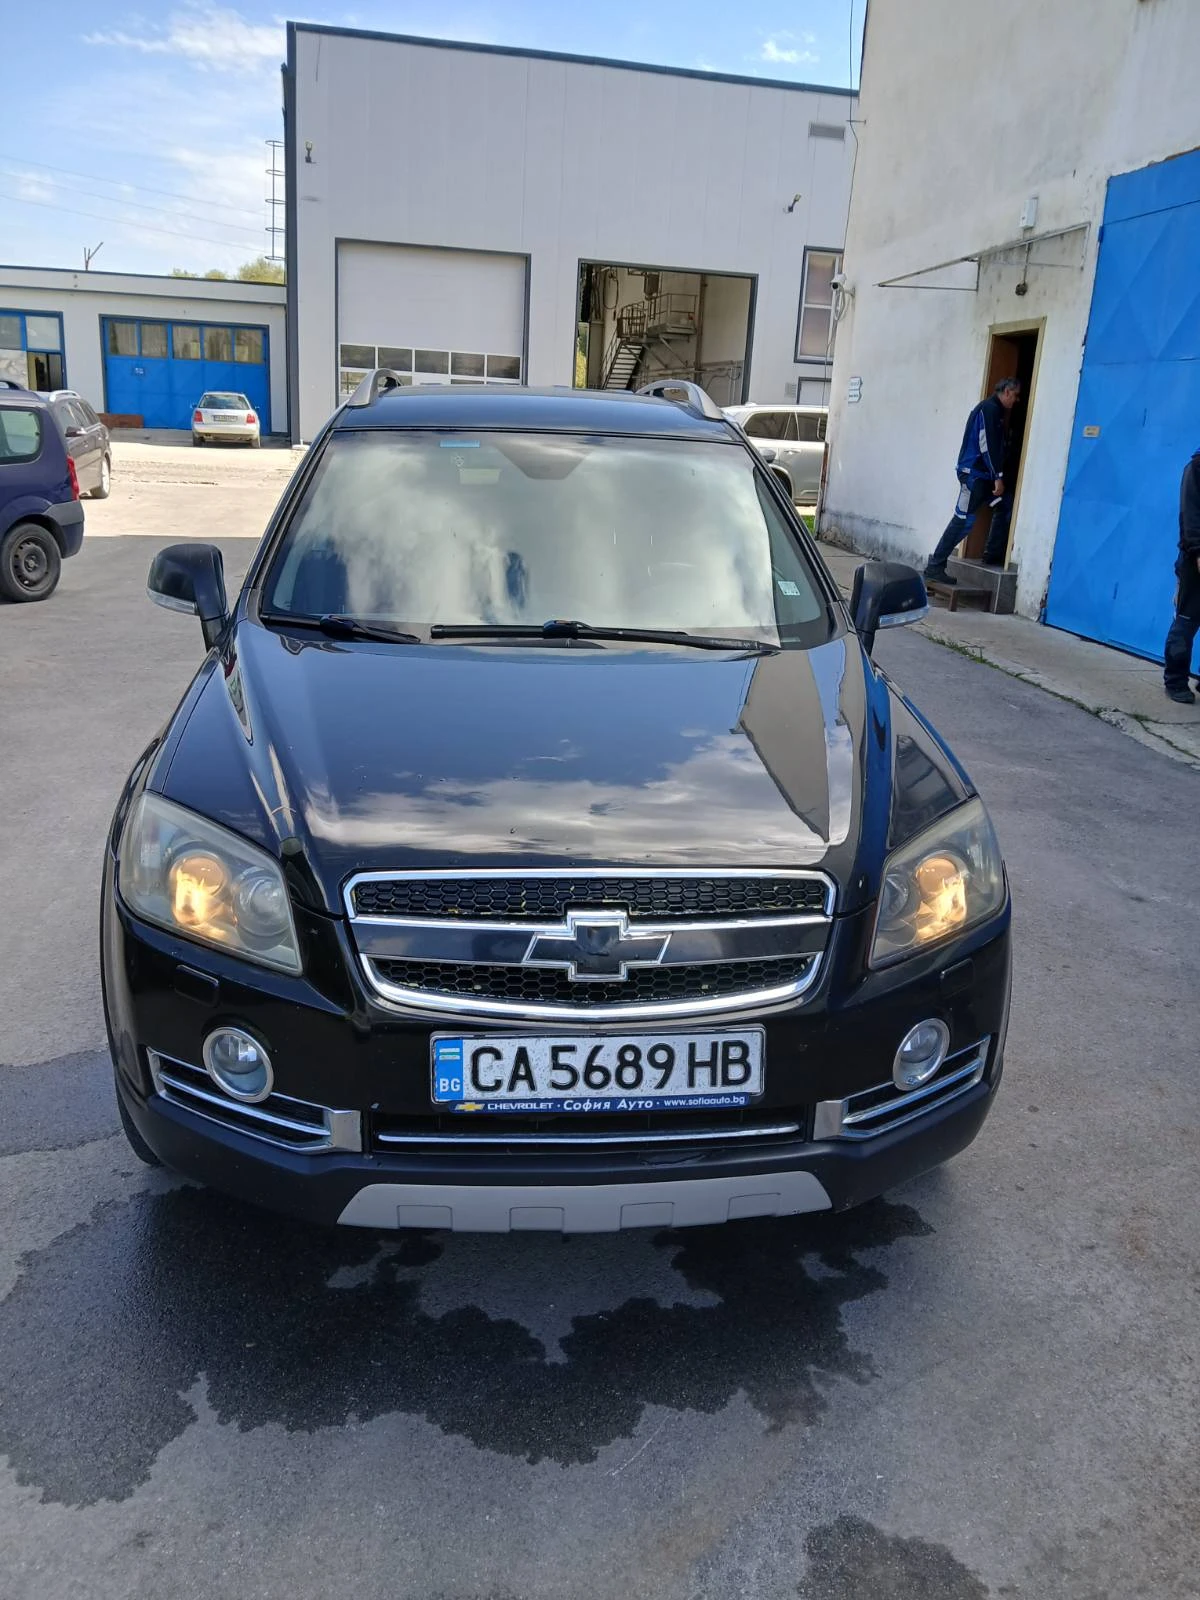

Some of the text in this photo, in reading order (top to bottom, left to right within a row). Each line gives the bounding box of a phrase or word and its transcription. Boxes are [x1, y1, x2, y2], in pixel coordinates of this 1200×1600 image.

[471, 1039, 752, 1093] CA 5689 HB
[439, 1078, 461, 1092] BG
[487, 1095, 746, 1111] CHEVROLET София Ауто www.sofiaauto.bg
